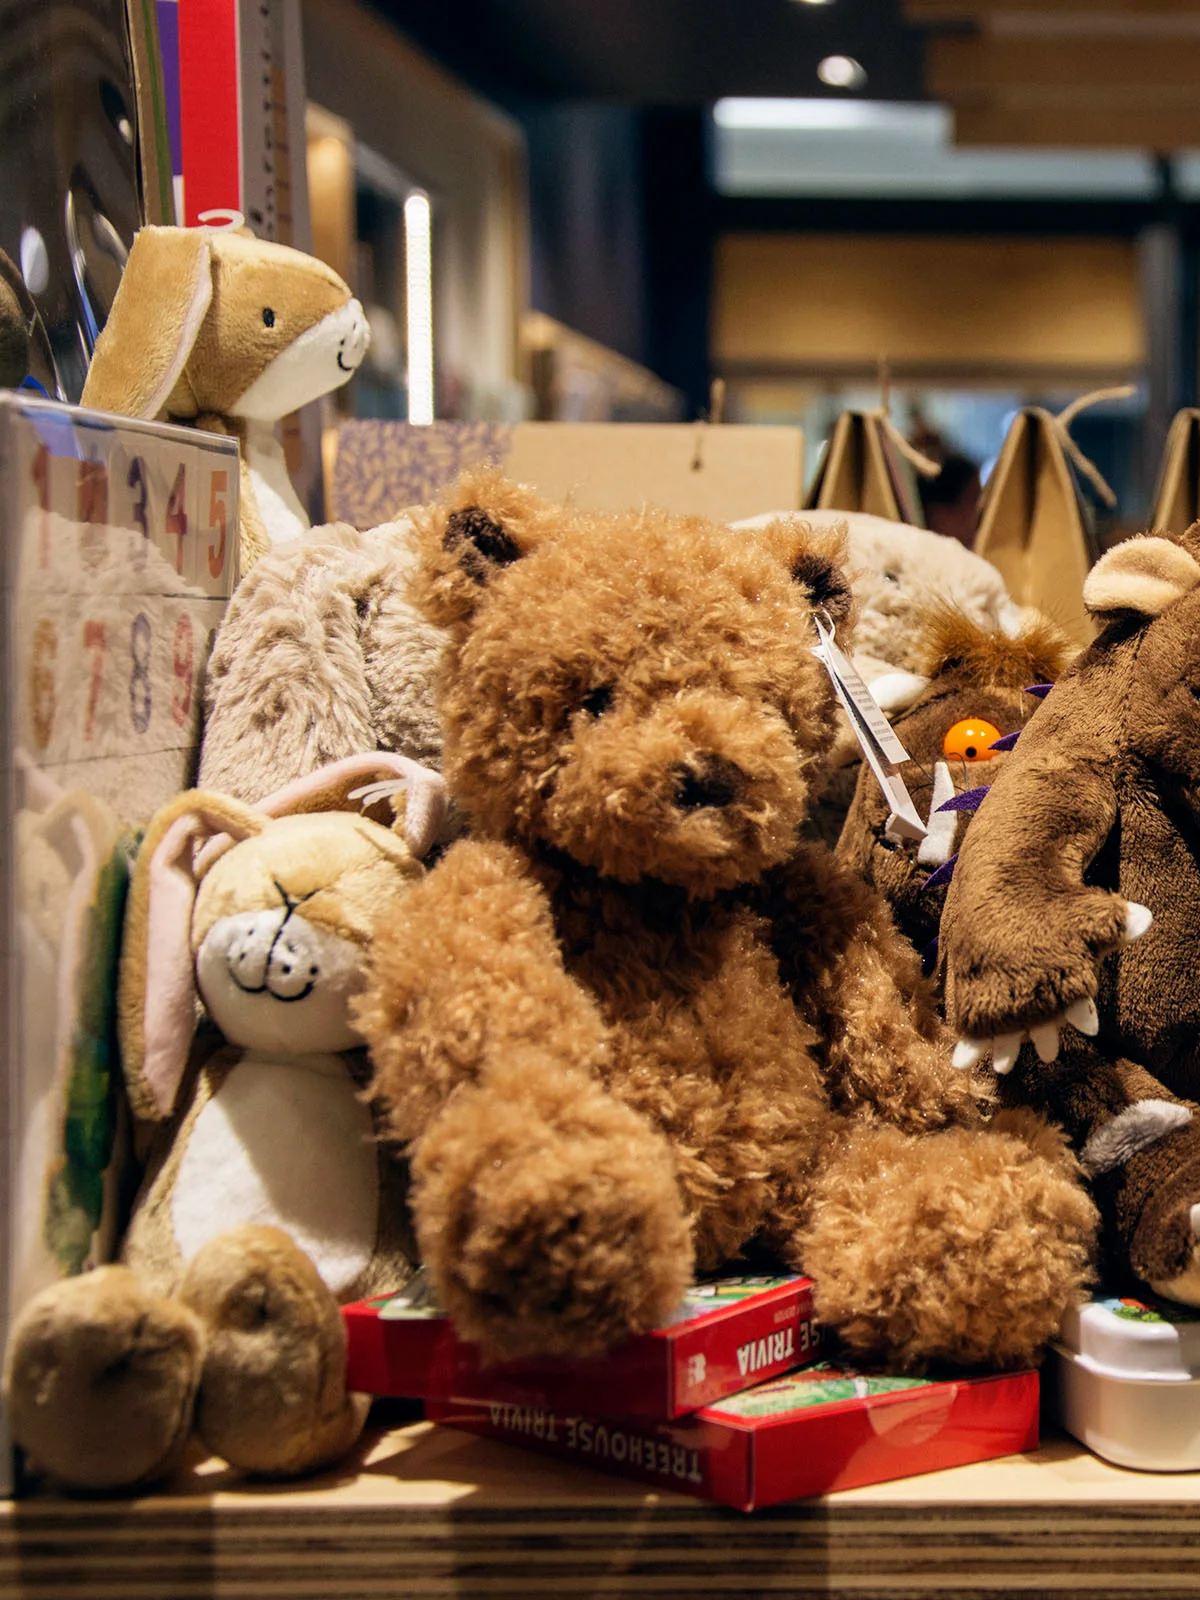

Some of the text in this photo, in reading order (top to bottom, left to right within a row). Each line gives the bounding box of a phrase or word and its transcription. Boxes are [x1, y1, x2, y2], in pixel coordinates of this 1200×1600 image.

[165, 462, 189, 576] 4
[208, 470, 228, 579] 5
[83, 620, 106, 741] 7
[131, 612, 152, 734] 8
[172, 612, 194, 728] 9
[736, 1326, 795, 1377] TRIVIA
[490, 1403, 702, 1484] TREEHOUSE TRIVIA
